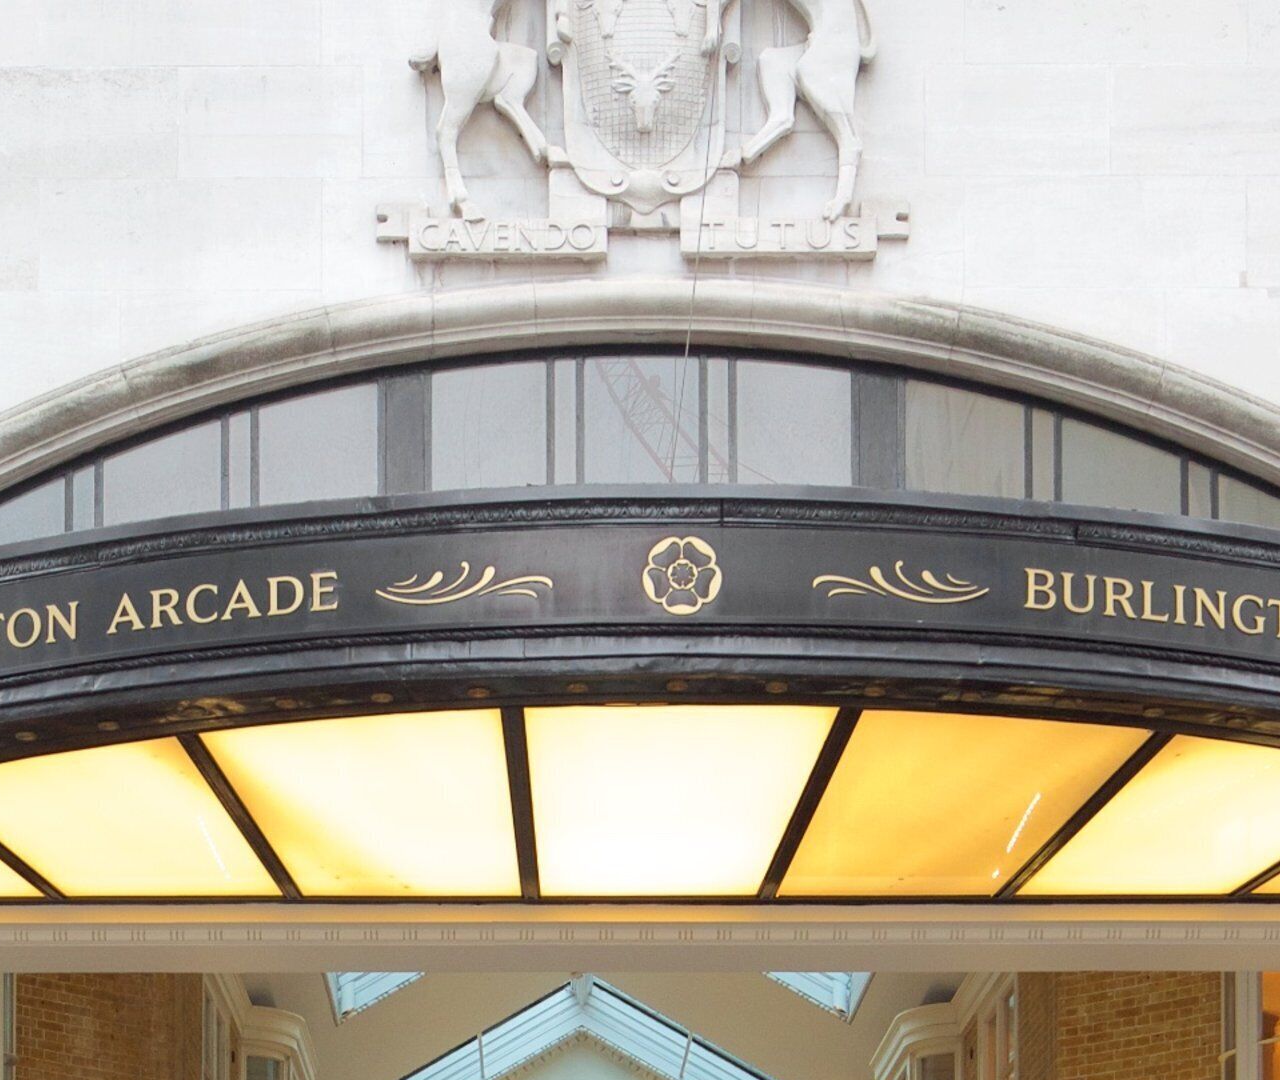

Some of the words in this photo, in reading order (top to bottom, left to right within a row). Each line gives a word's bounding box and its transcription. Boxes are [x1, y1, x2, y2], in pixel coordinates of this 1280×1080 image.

[418, 221, 597, 251] CAVENDO
[699, 220, 862, 250] TUTUS
[106, 571, 339, 635] ARCADE
